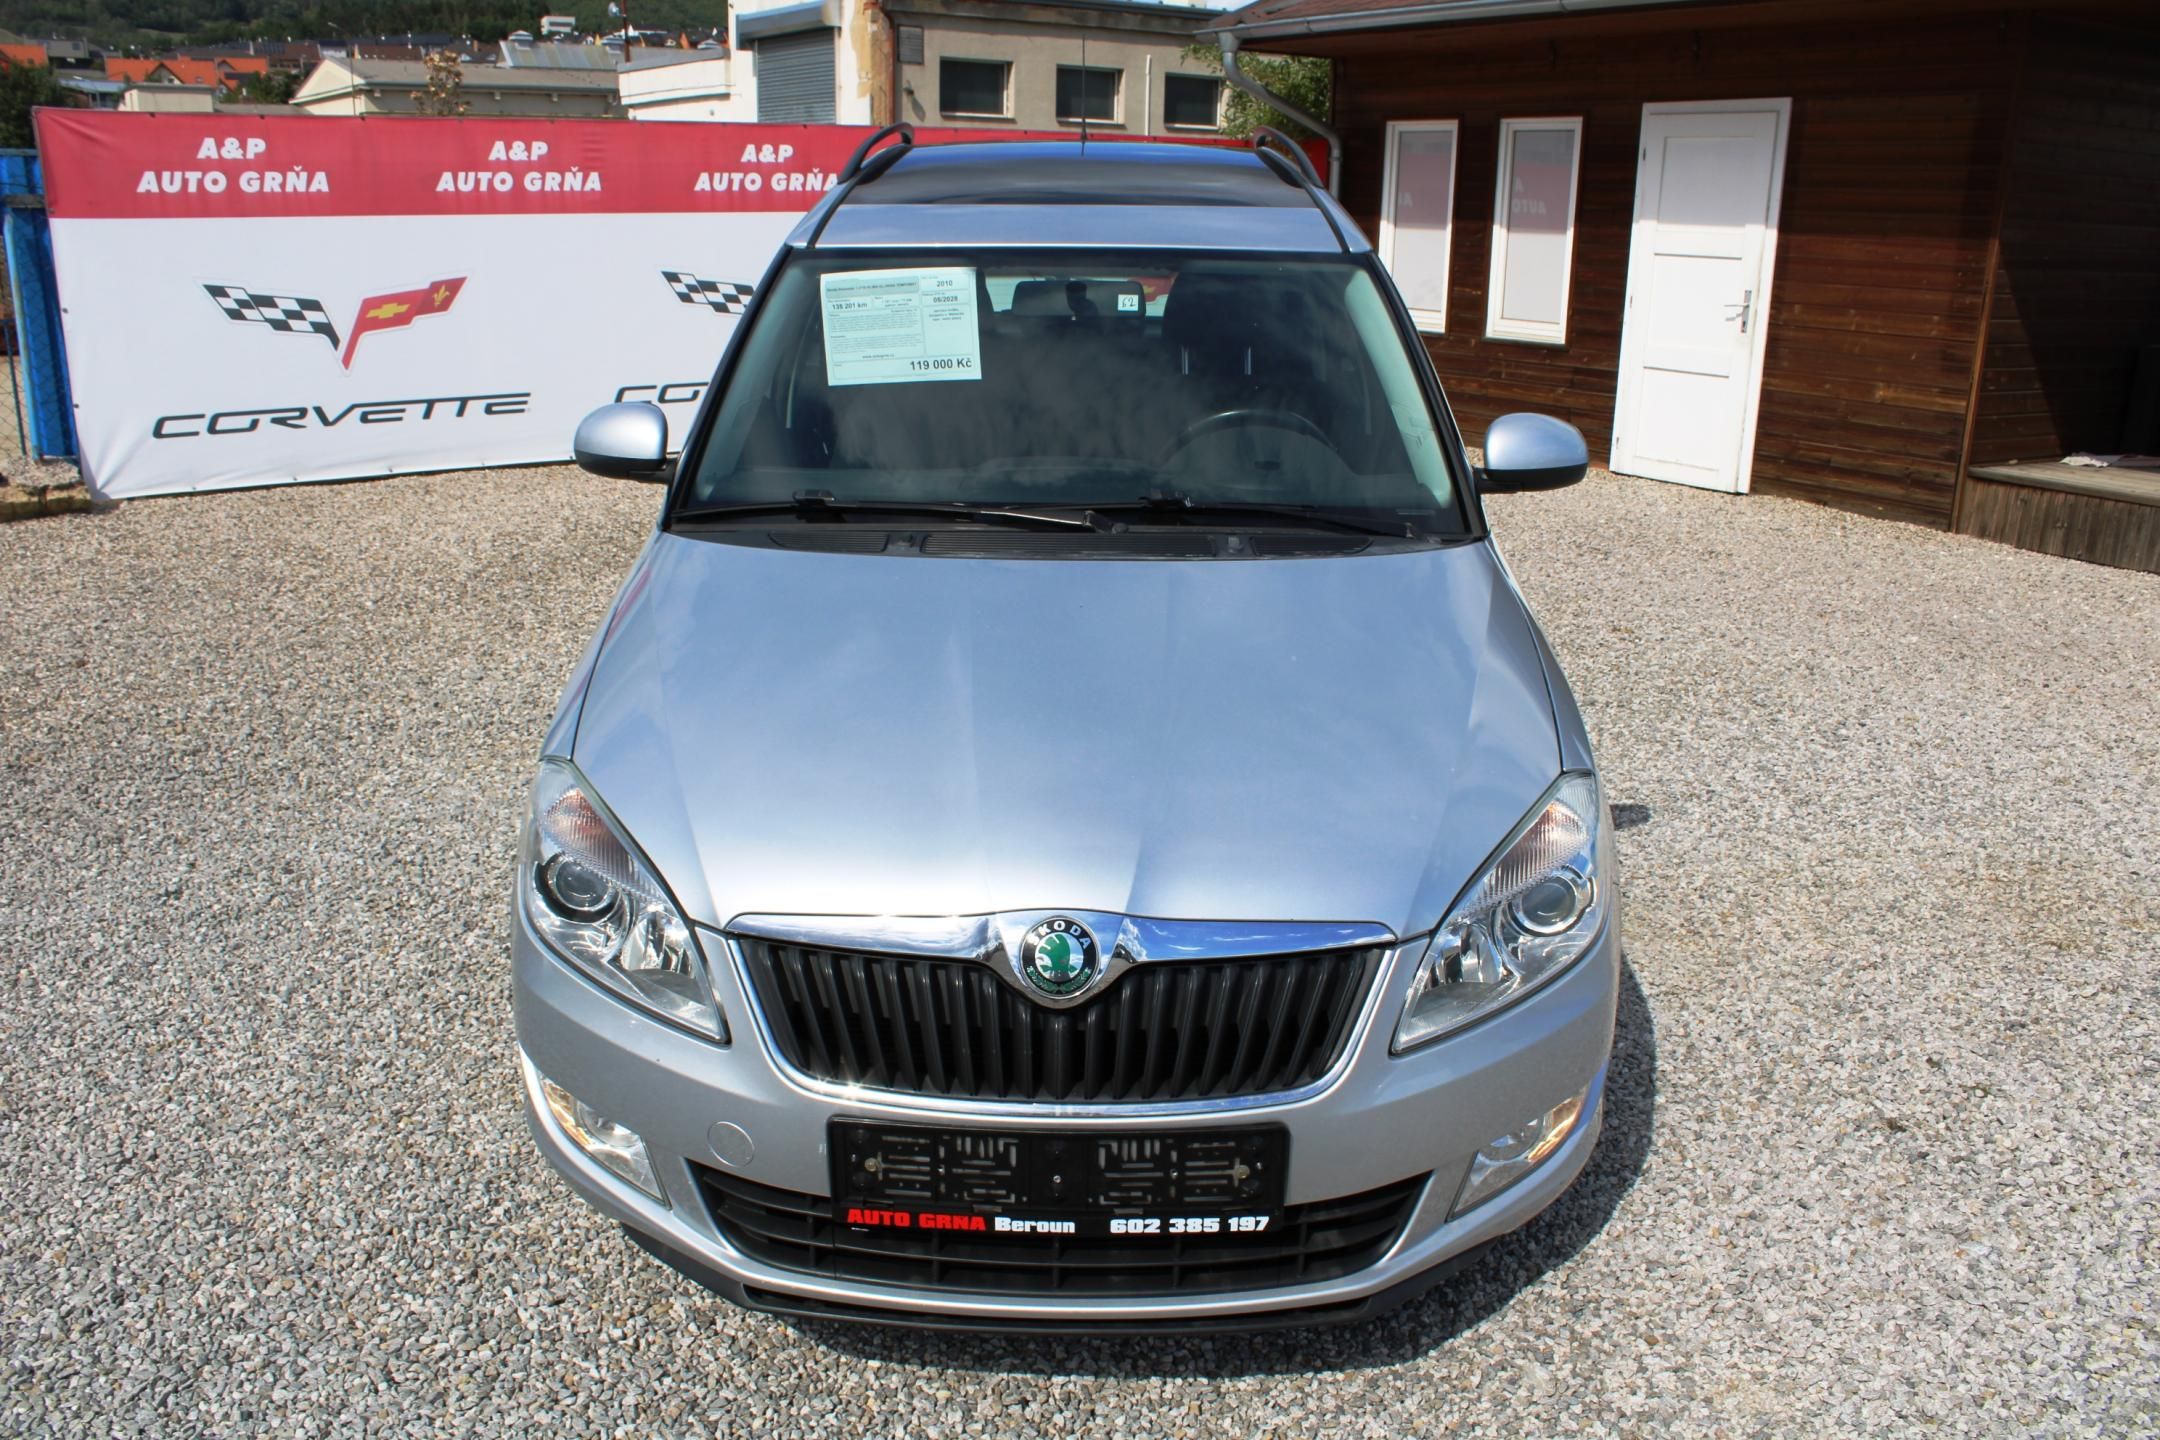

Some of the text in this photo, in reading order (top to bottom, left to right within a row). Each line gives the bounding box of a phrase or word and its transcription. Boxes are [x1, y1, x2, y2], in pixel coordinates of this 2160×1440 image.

[196, 137, 267, 159] A&P
[488, 140, 549, 161] A&P
[740, 144, 794, 163] A&P
[136, 165, 330, 193] AUTO GRŇA
[435, 166, 602, 192] AUTO GRŇA
[694, 172, 763, 192] AUTO
[936, 280, 953, 288] 2010
[910, 357, 973, 371] 119 000 Kč
[152, 392, 531, 439] CORVETTE
[847, 1208, 1270, 1234] AUTO GRNA Beroun 602 385 197
